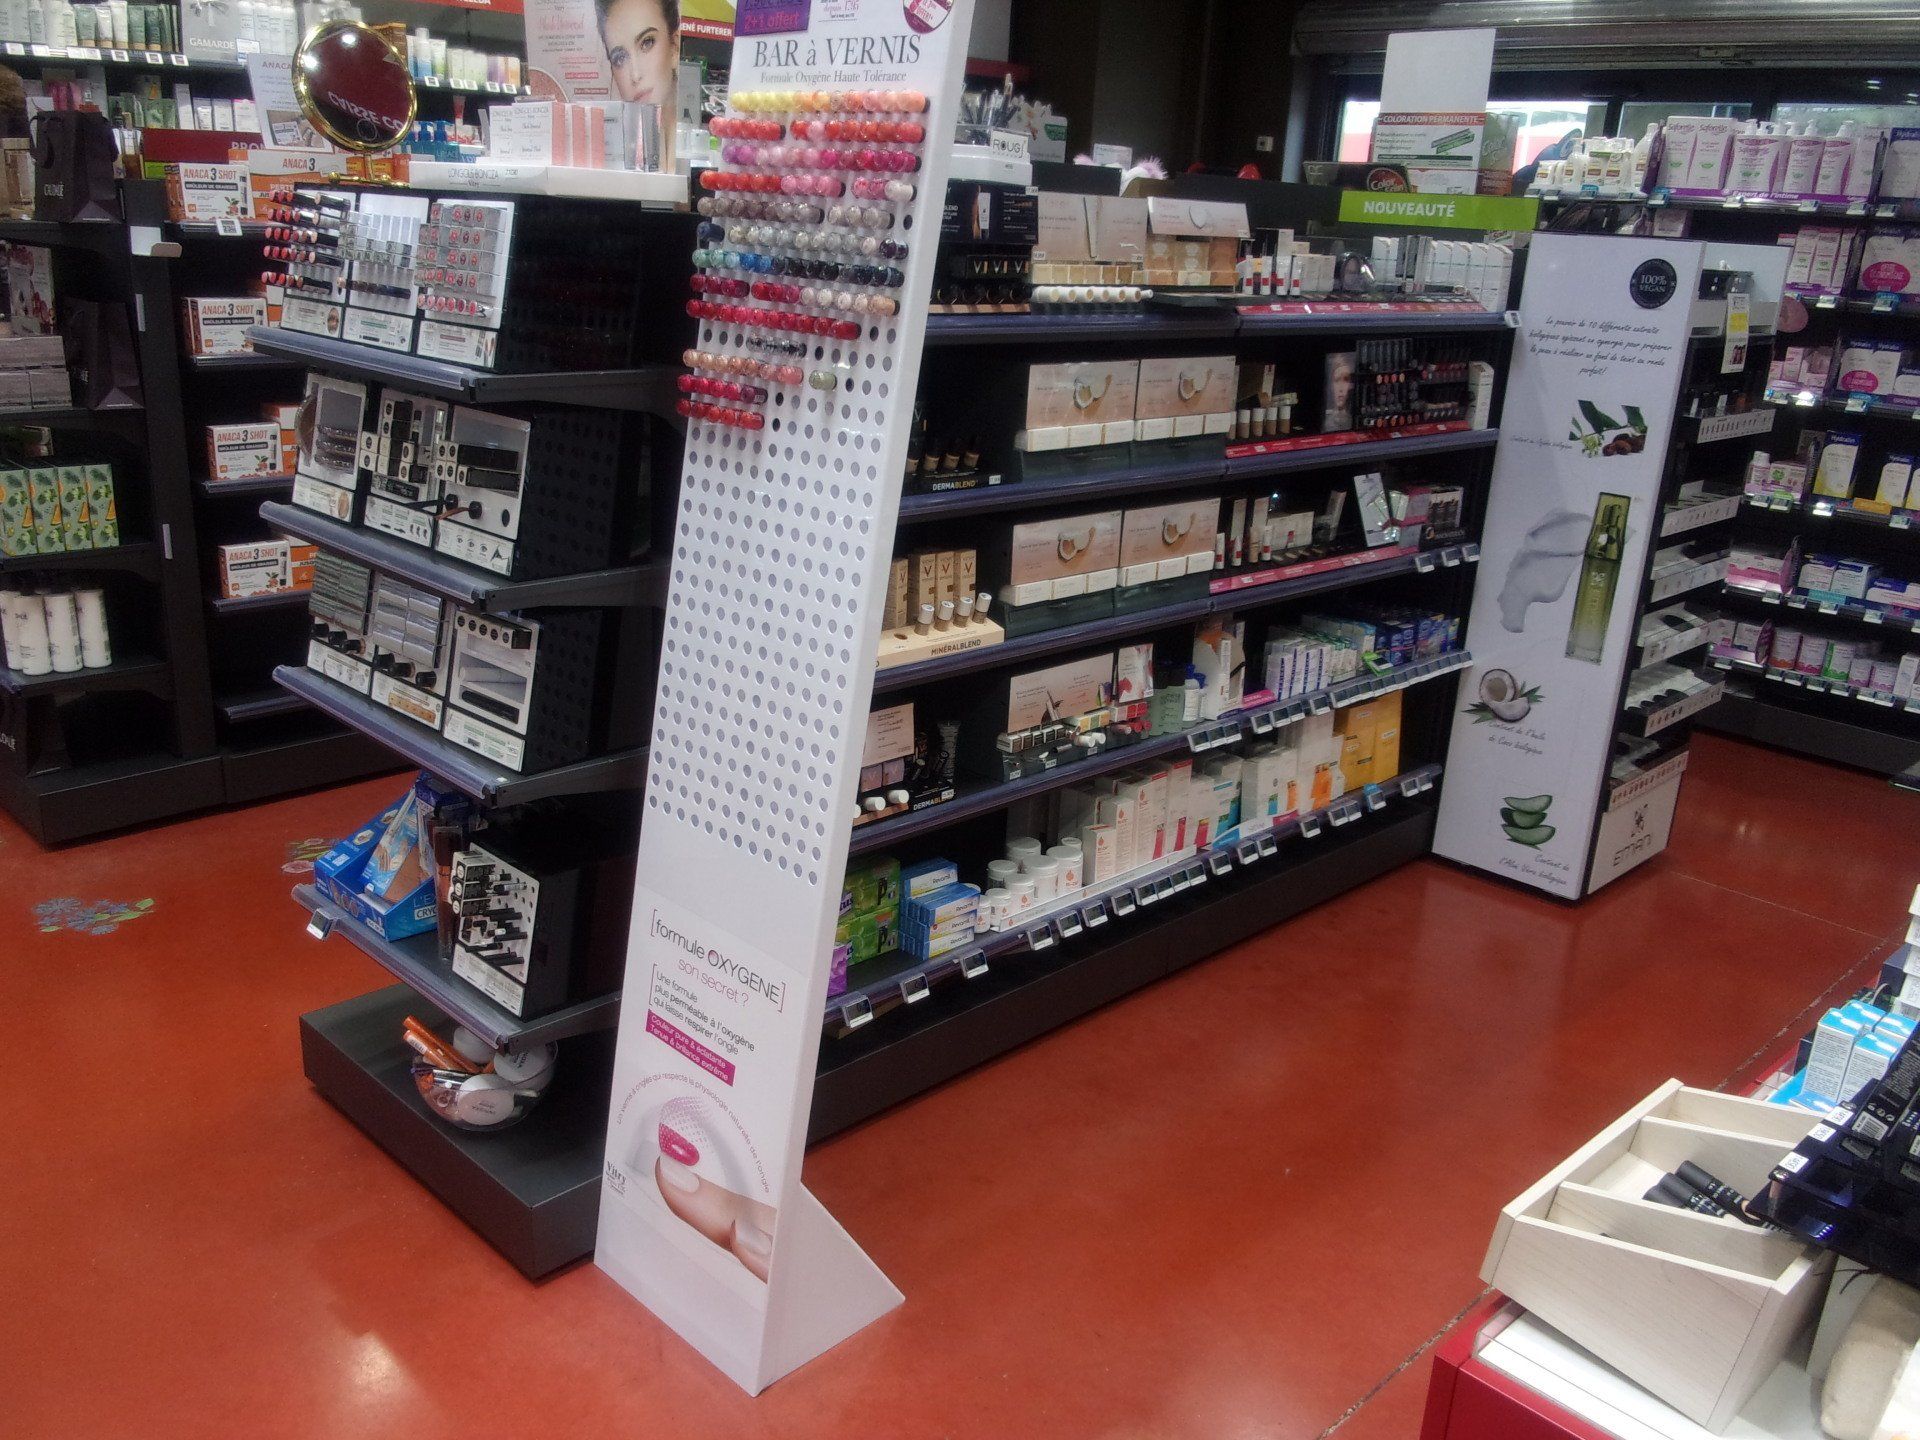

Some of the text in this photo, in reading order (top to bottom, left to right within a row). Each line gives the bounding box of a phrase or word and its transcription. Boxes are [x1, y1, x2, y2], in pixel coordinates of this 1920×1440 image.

[743, 11, 800, 32] 2+1 offert
[190, 37, 236, 50] GAMARDE
[753, 34, 921, 67] BAR à VERNIS
[760, 71, 907, 86] Formule Oxygène Haute Tolérance
[1383, 115, 1478, 123] COLORATION PERMANENTE
[283, 158, 315, 171] ANACA 3
[184, 167, 237, 181] ANACA 3 SHOT
[1732, 191, 1758, 199] Expert
[1759, 191, 1768, 199] de
[1364, 200, 1456, 217] NOUVEAUTÉ
[1641, 275, 1667, 285] 100%
[202, 303, 254, 316] ANACA 3 SHOT
[217, 429, 268, 442] ANACA 3 SHOT
[933, 480, 976, 491] DERMABLEND
[229, 548, 278, 560] ANACA 3 SHOT
[657, 970, 698, 1002] Une formule
[678, 959, 749, 1007] son secret ?
[653, 997, 739, 1055] qui laisse respirer l'ongle
[655, 985, 755, 1052] plus perméable à l'oxygène
[651, 1016, 674, 1035] Couleur
[675, 1031, 689, 1045] pure
[650, 1023, 669, 1041] Tenue
[701, 1059, 729, 1081] extrême
[636, 1075, 653, 1092] ongles
[662, 1072, 688, 1083] respecte
[695, 1082, 729, 1112] physiologie
